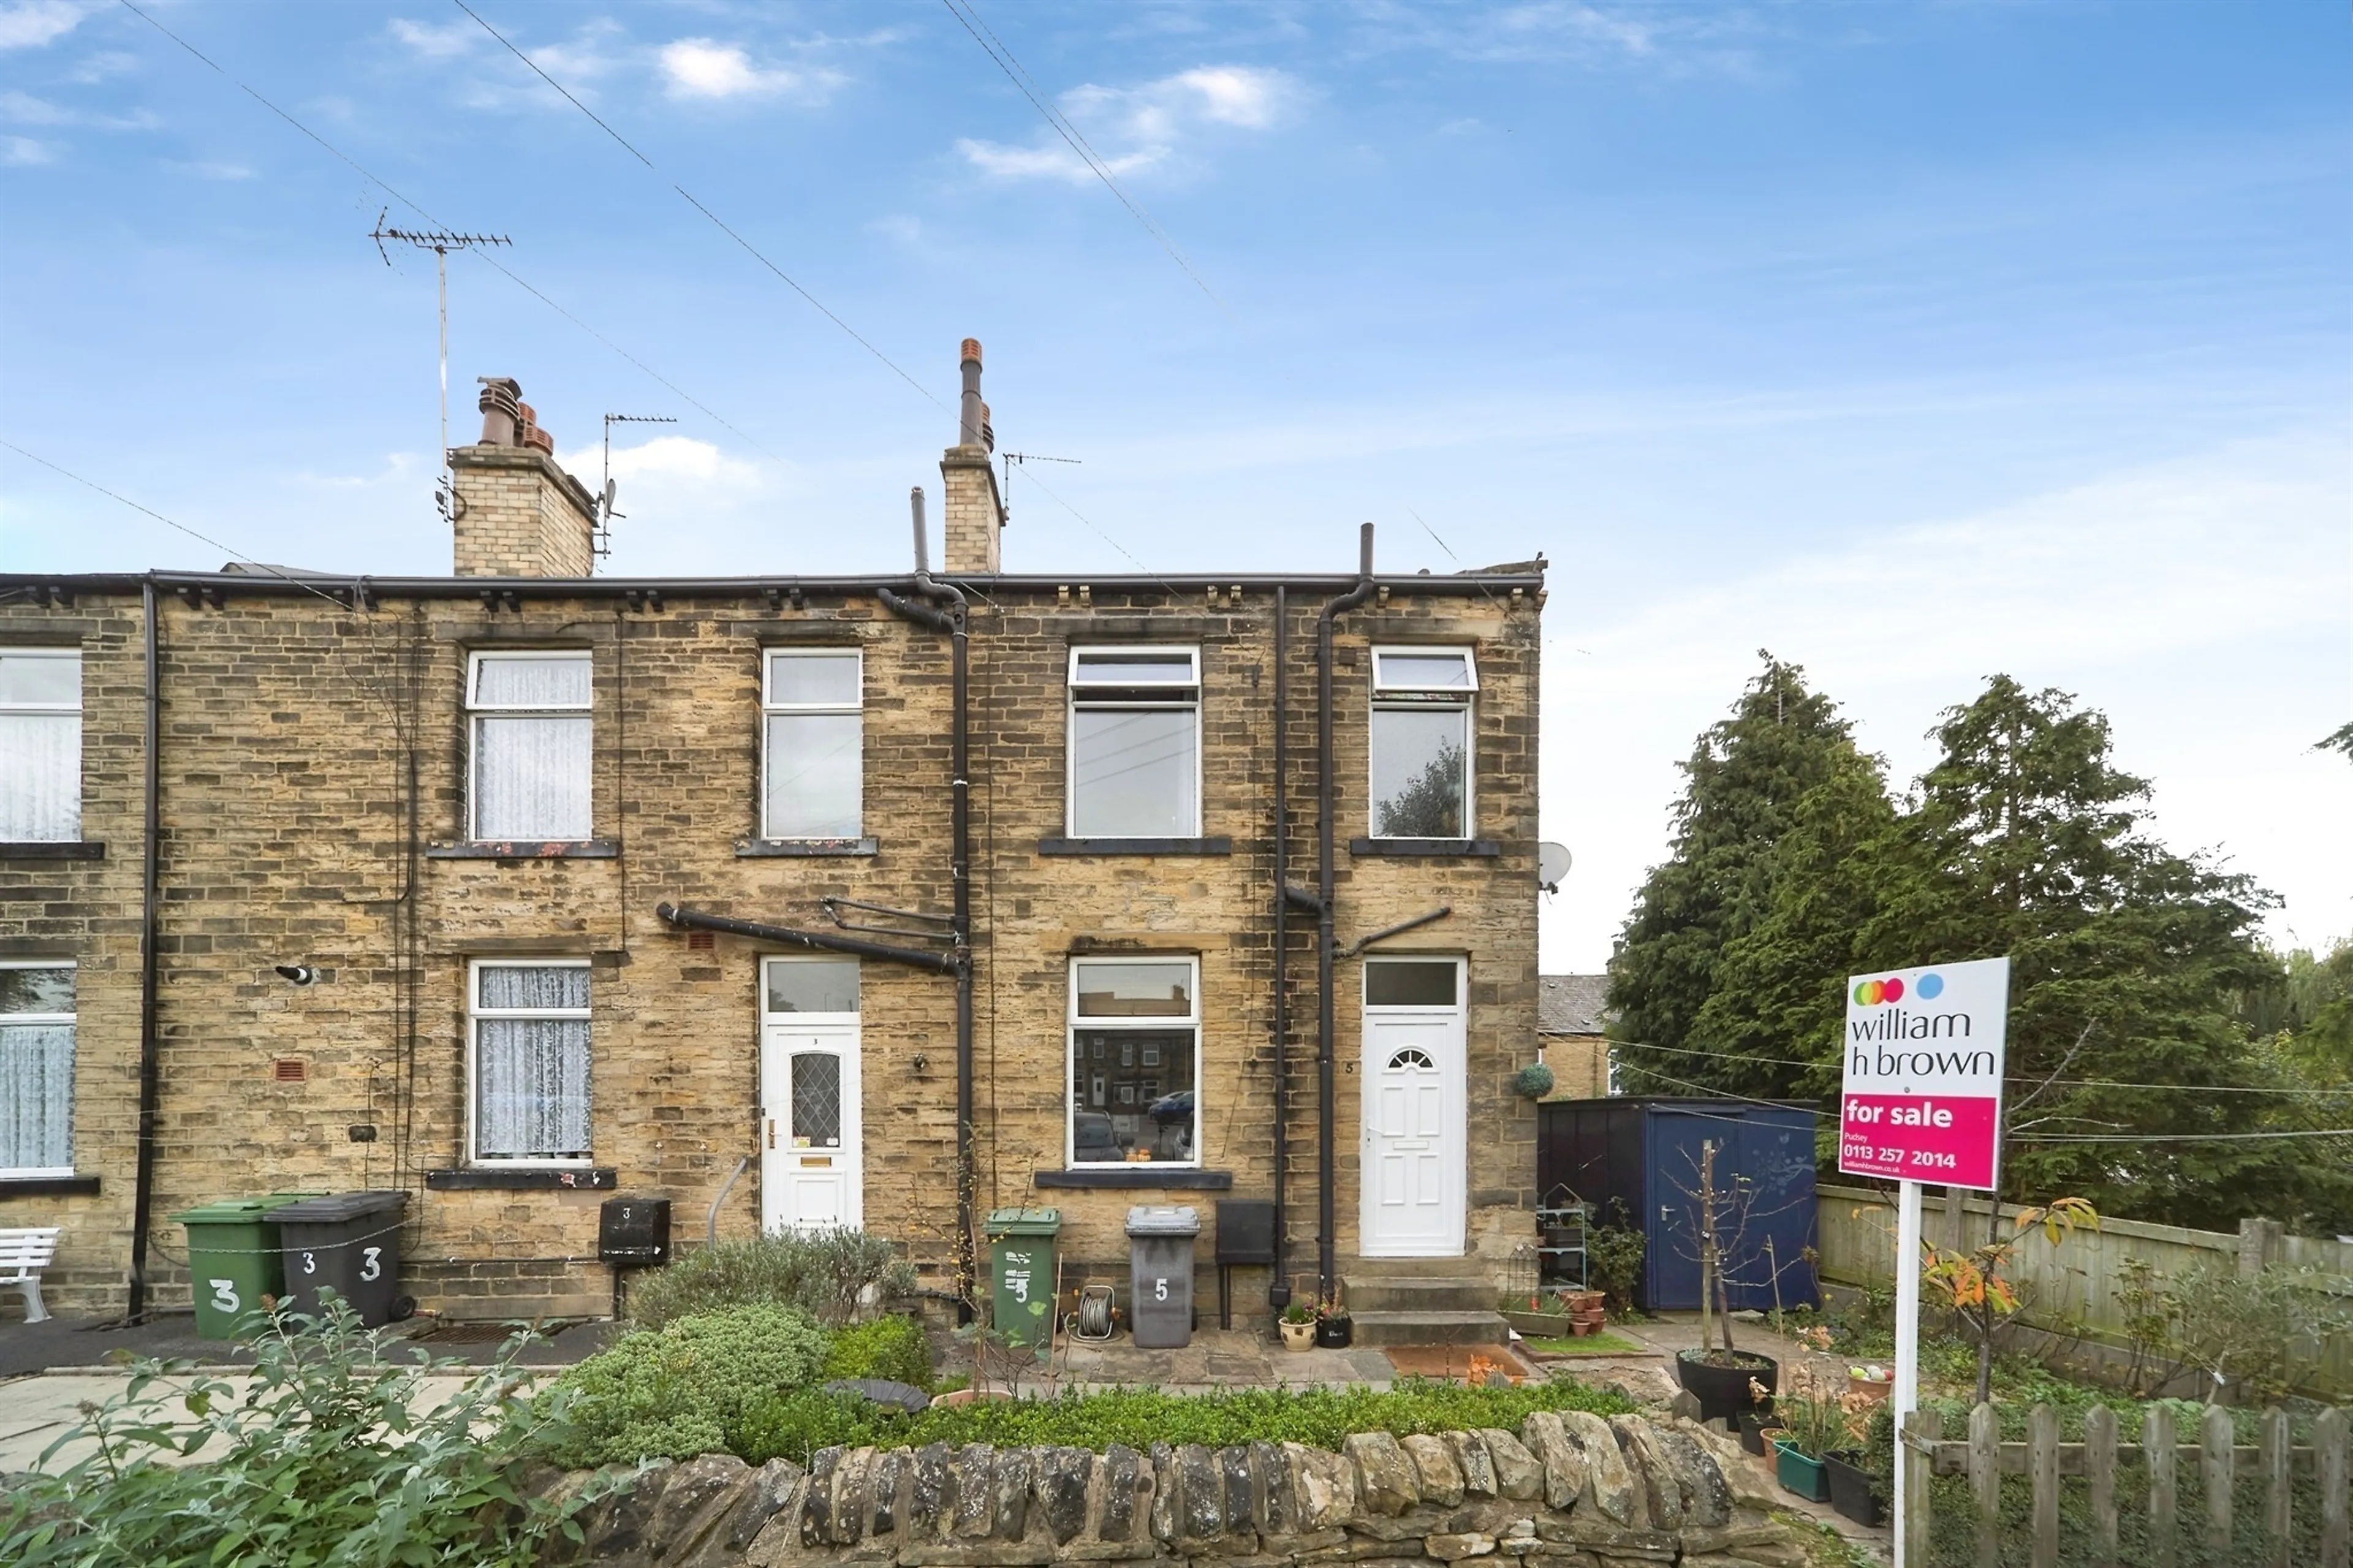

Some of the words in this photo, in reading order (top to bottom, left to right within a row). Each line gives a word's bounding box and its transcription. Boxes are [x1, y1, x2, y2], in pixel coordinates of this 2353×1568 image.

[1852, 1008, 1970, 1041] william
[1345, 1061, 1353, 1074] 5
[1852, 1046, 1868, 1075] h
[1877, 1045, 1995, 1076] brown
[1846, 1099, 1884, 1123] for
[1890, 1101, 1953, 1128] sale
[1844, 1132, 1868, 1143] Pudsey
[1844, 1144, 1873, 1160] 0113
[1878, 1147, 1905, 1163] 257
[1911, 1150, 1957, 1168] 2014
[623, 1207, 631, 1219] 3
[302, 1252, 316, 1274] 3
[359, 1246, 382, 1281] 3
[209, 1279, 240, 1312] 3
[1155, 1278, 1168, 1301] 5
